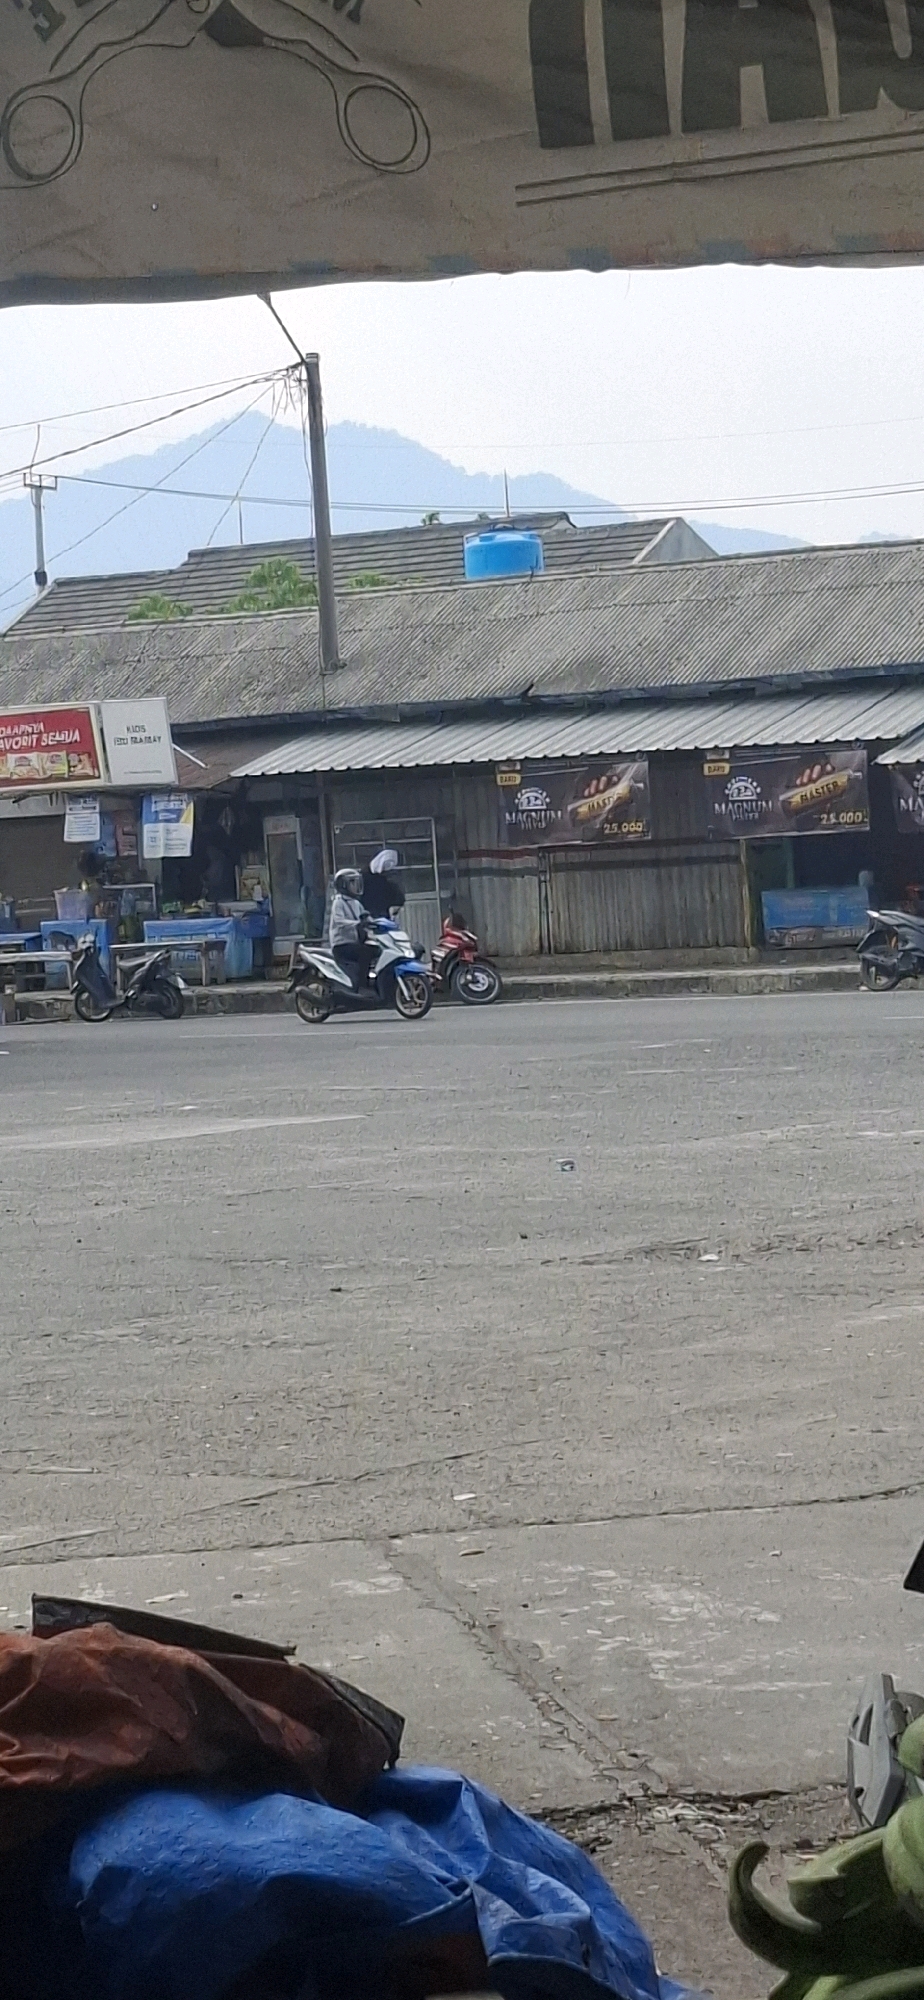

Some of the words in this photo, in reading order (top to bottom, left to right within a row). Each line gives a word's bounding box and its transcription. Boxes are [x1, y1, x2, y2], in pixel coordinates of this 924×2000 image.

[41, 729, 81, 746] SEMUA
[800, 780, 838, 804] MASTER
[714, 801, 772, 814] MAGNUM
[505, 810, 562, 824] MAGNUM
[603, 822, 643, 833] 25.000
